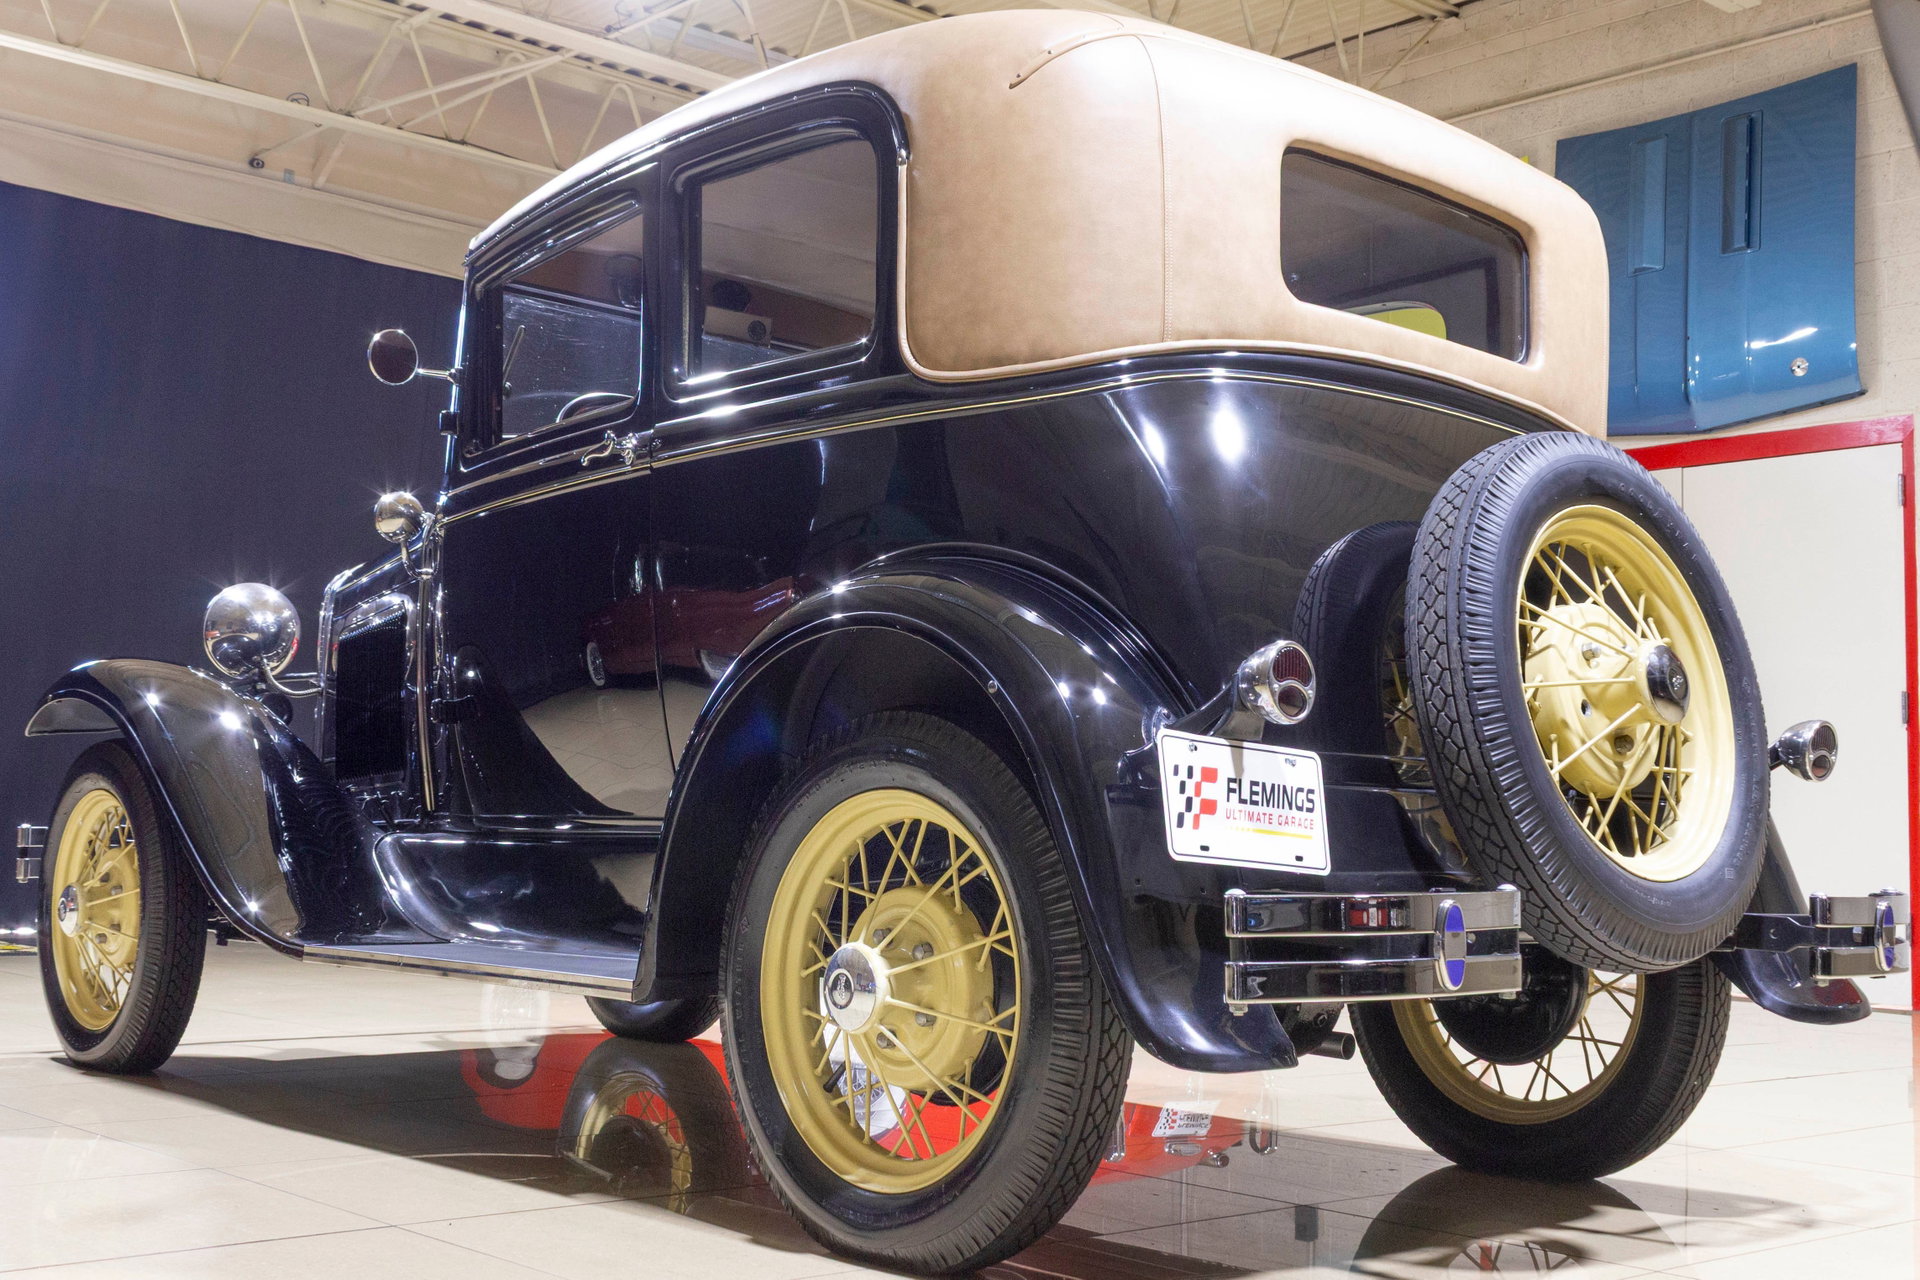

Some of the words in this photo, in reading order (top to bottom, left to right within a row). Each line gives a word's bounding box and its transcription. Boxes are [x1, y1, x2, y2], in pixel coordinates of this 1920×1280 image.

[1226, 777, 1315, 813] FLEMINGS
[1226, 808, 1273, 825] ULTIMATE
[1277, 814, 1314, 830] GARAGE
